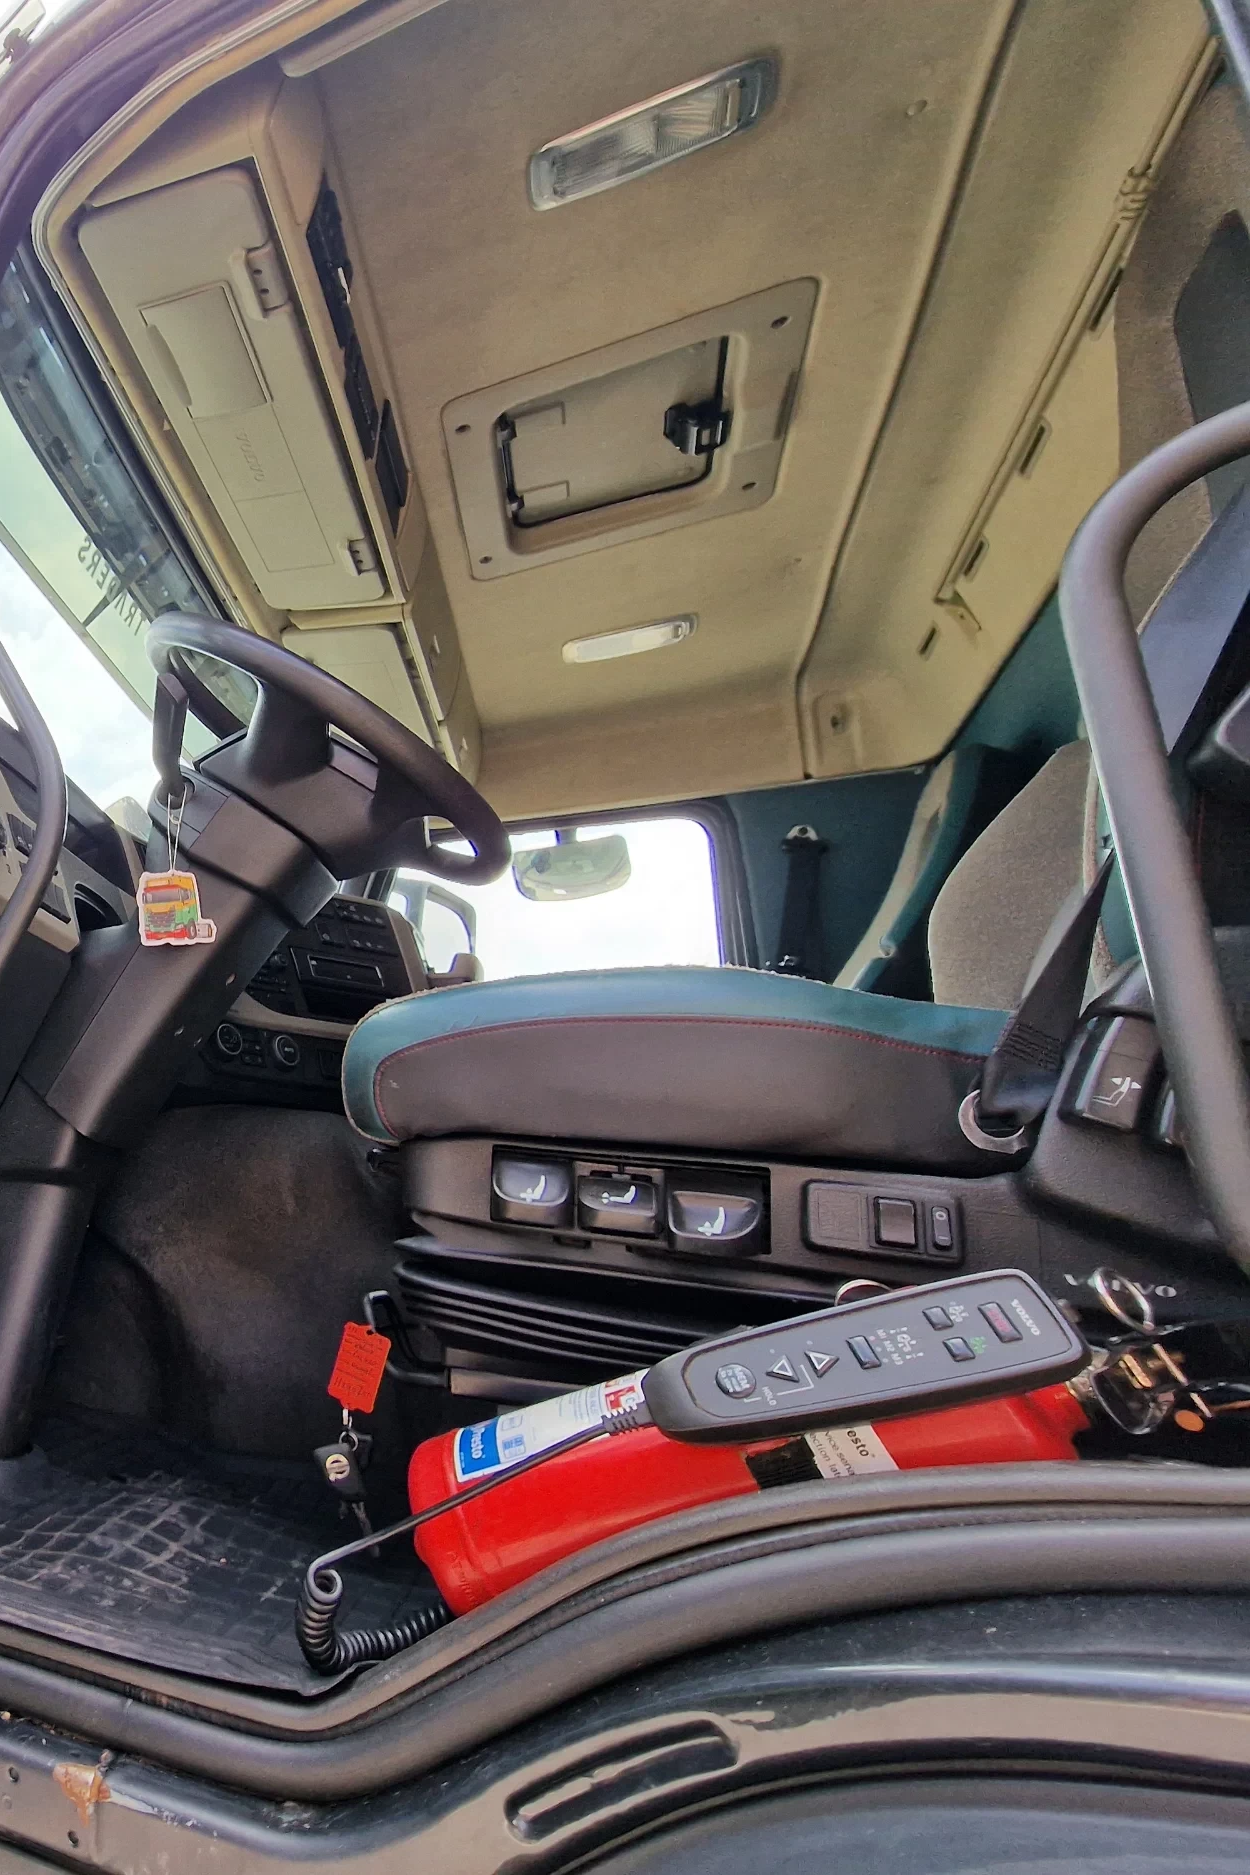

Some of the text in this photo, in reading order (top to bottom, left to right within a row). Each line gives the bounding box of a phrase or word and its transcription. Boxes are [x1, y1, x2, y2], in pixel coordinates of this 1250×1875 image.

[1063, 1273, 1177, 1298] VLVO
[1011, 1298, 1041, 1336] VOLVO
[846, 1428, 869, 1457] esto
[829, 1463, 842, 1477] lat
